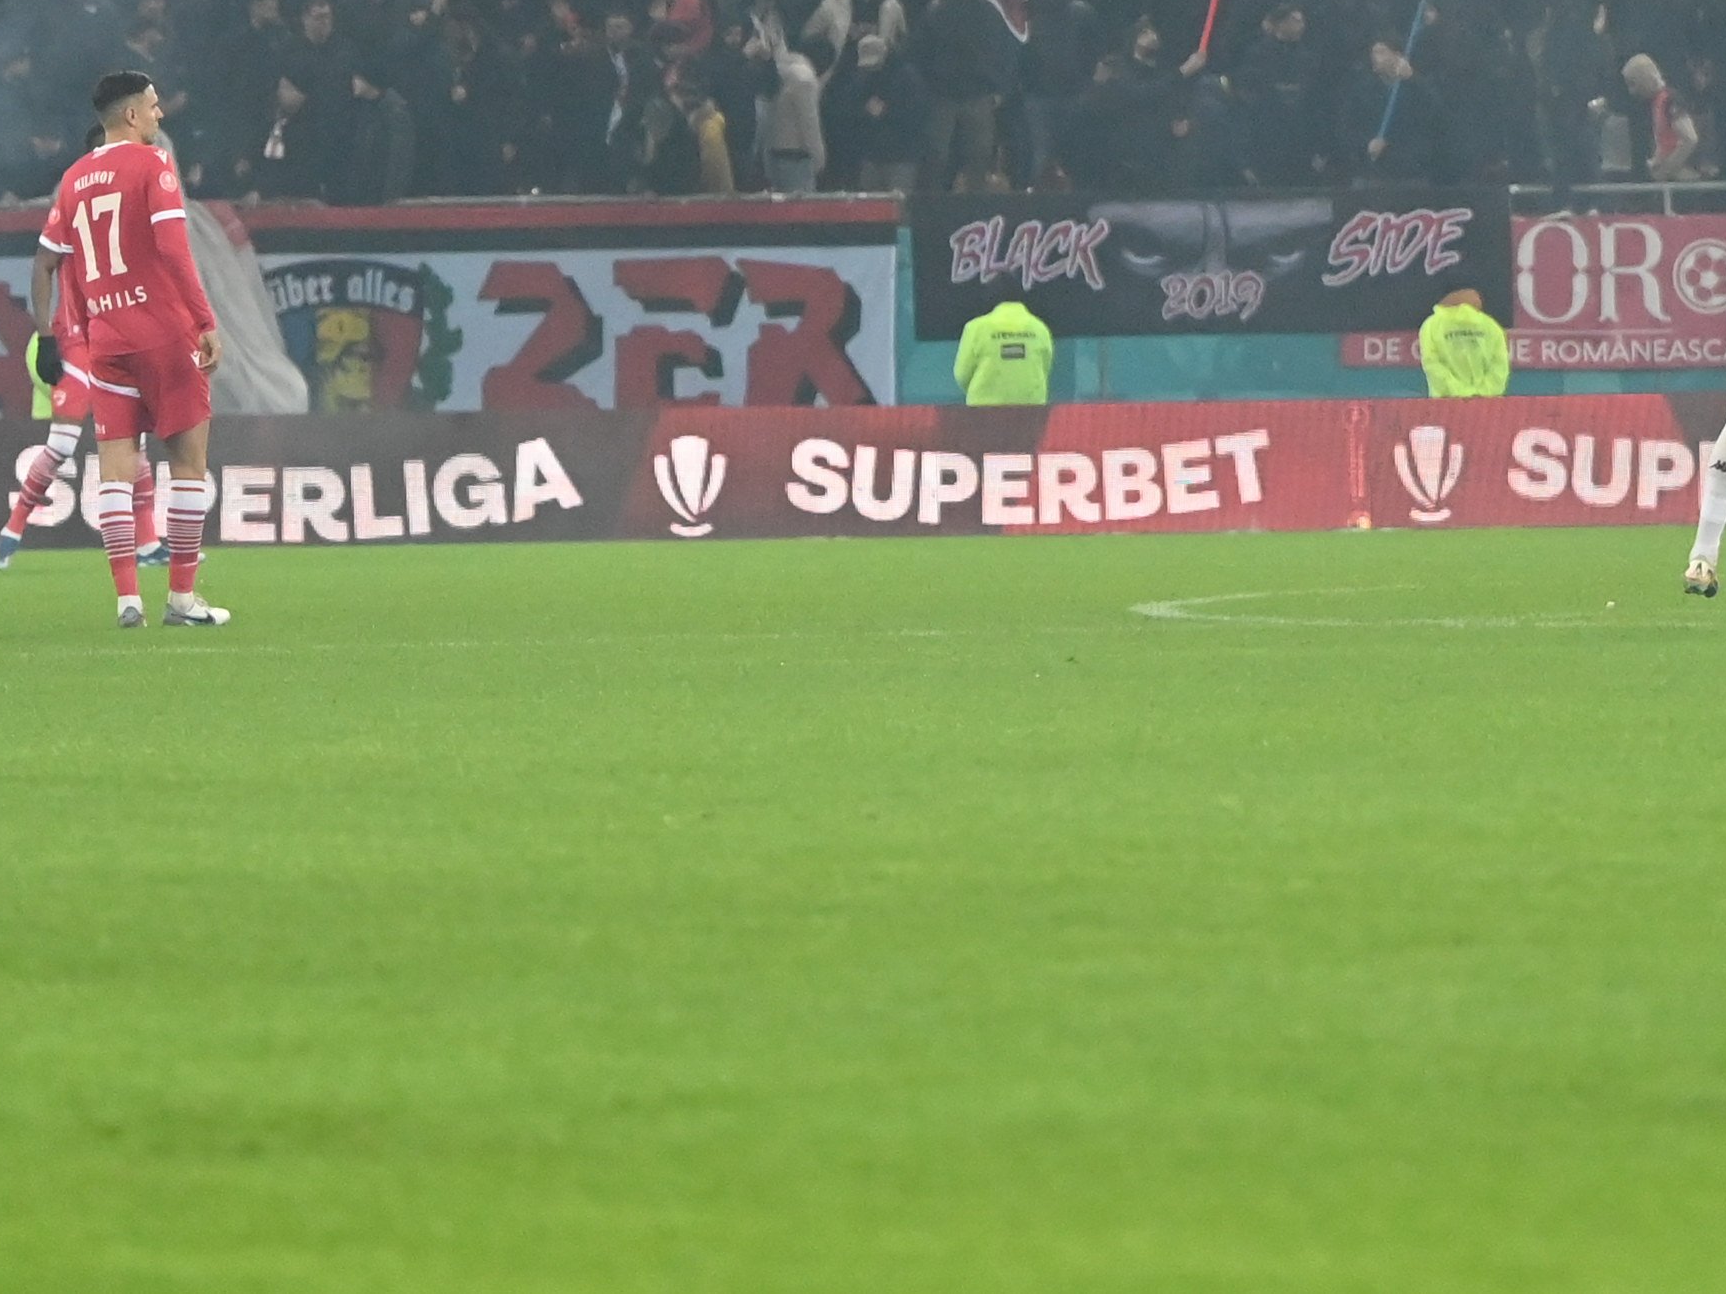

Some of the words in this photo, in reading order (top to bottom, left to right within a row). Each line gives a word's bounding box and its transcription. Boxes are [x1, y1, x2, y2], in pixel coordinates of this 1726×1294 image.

[71, 191, 129, 282] 17
[950, 216, 1110, 290] BLACK
[1322, 208, 1472, 288] SIDE
[348, 265, 416, 314] alles
[1161, 270, 1265, 322] 2019
[784, 429, 1270, 527] SUPERBET
